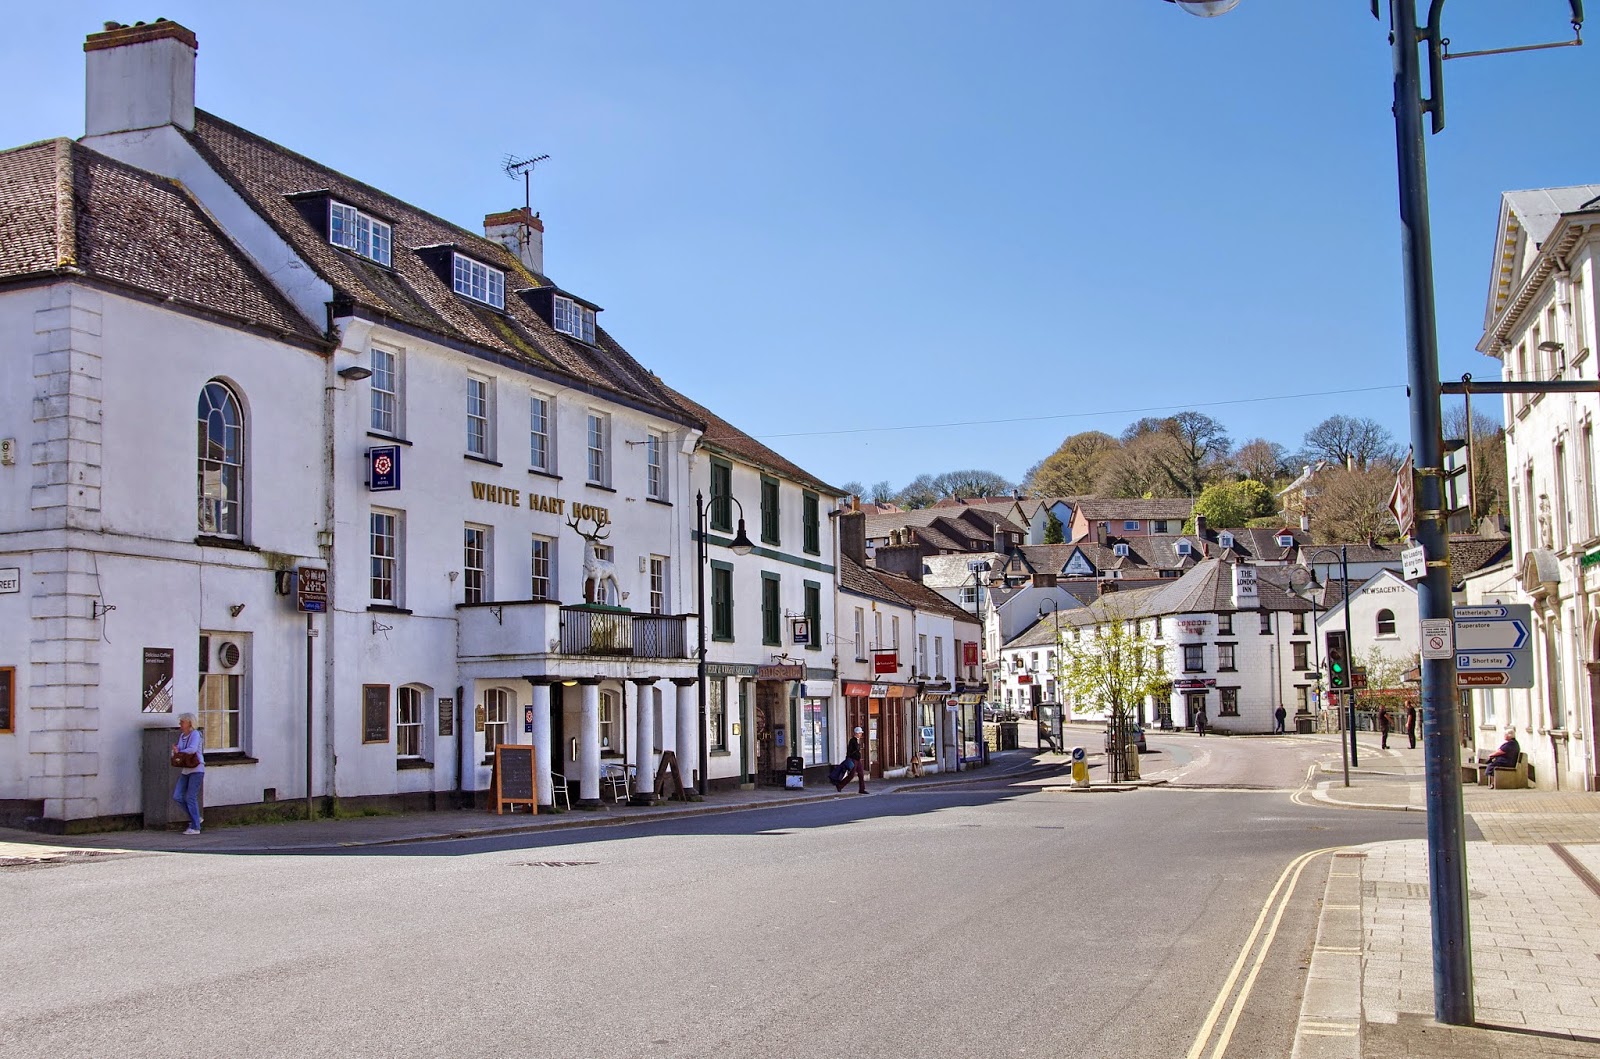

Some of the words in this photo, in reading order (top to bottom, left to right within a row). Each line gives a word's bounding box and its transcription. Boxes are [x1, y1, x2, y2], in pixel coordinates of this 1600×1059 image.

[471, 481, 520, 507] WHITE
[529, 493, 565, 515] HART
[572, 502, 611, 524] HOTEL
[1408, 549, 1423, 558] Loading
[1361, 586, 1405, 594] NEWSAGENTS
